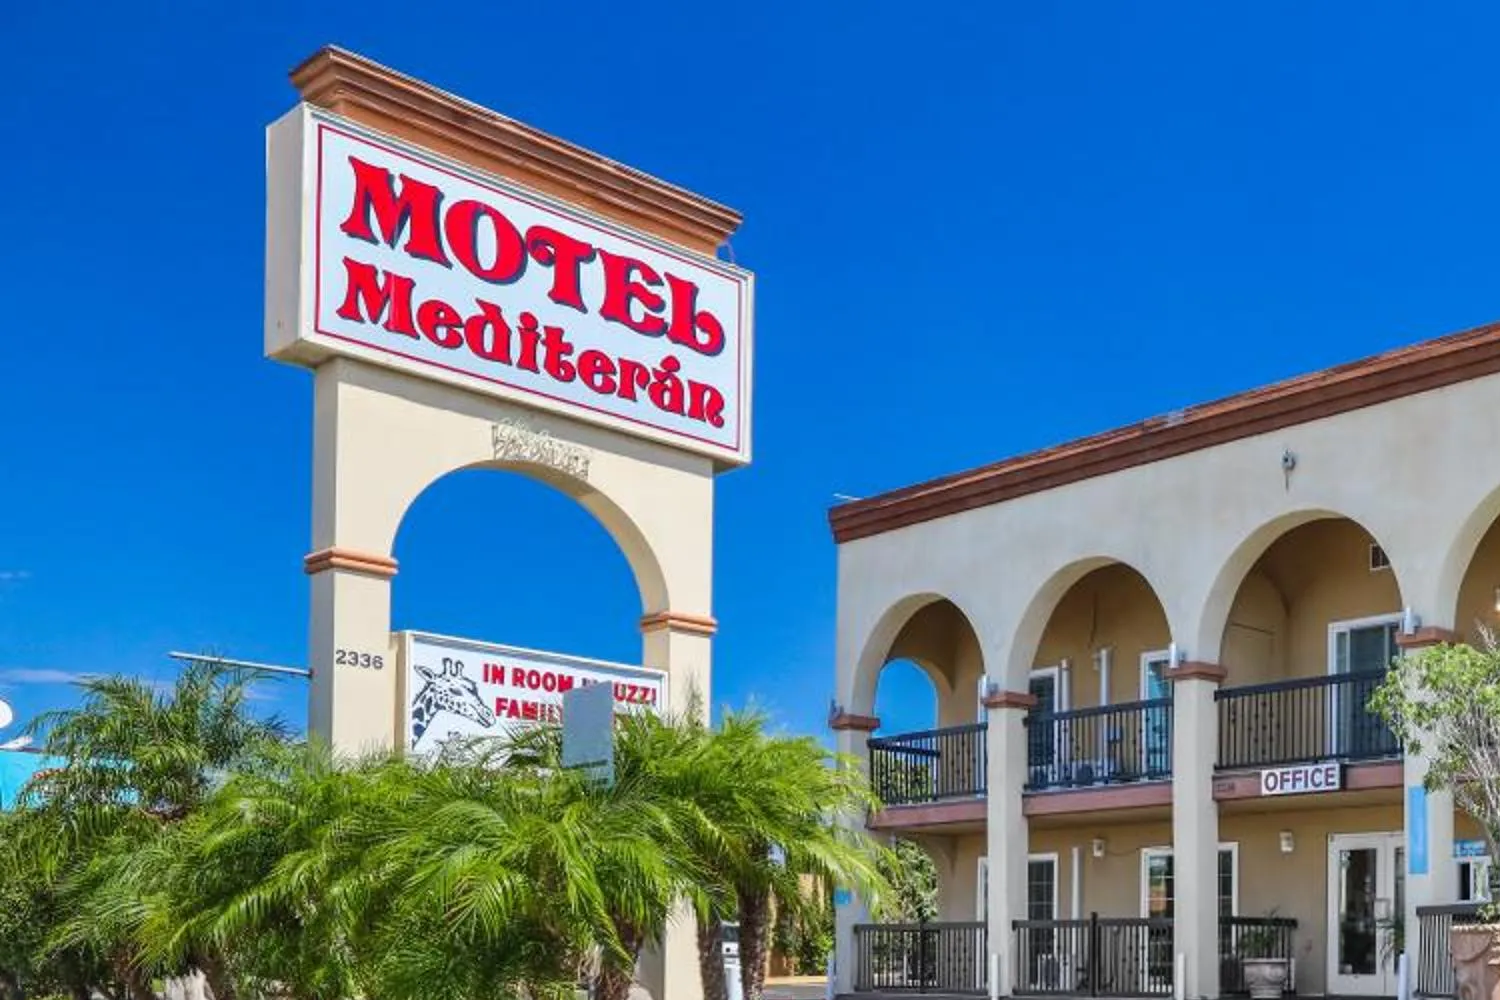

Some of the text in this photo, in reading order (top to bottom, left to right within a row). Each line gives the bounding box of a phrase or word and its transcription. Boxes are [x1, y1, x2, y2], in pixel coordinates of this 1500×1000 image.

[340, 156, 726, 356] MOTEL
[336, 256, 725, 429] Mediterán
[335, 649, 383, 670] 2336
[483, 663, 505, 685] IN
[512, 667, 574, 693] ROOM
[1264, 767, 1337, 792] OFFICE
